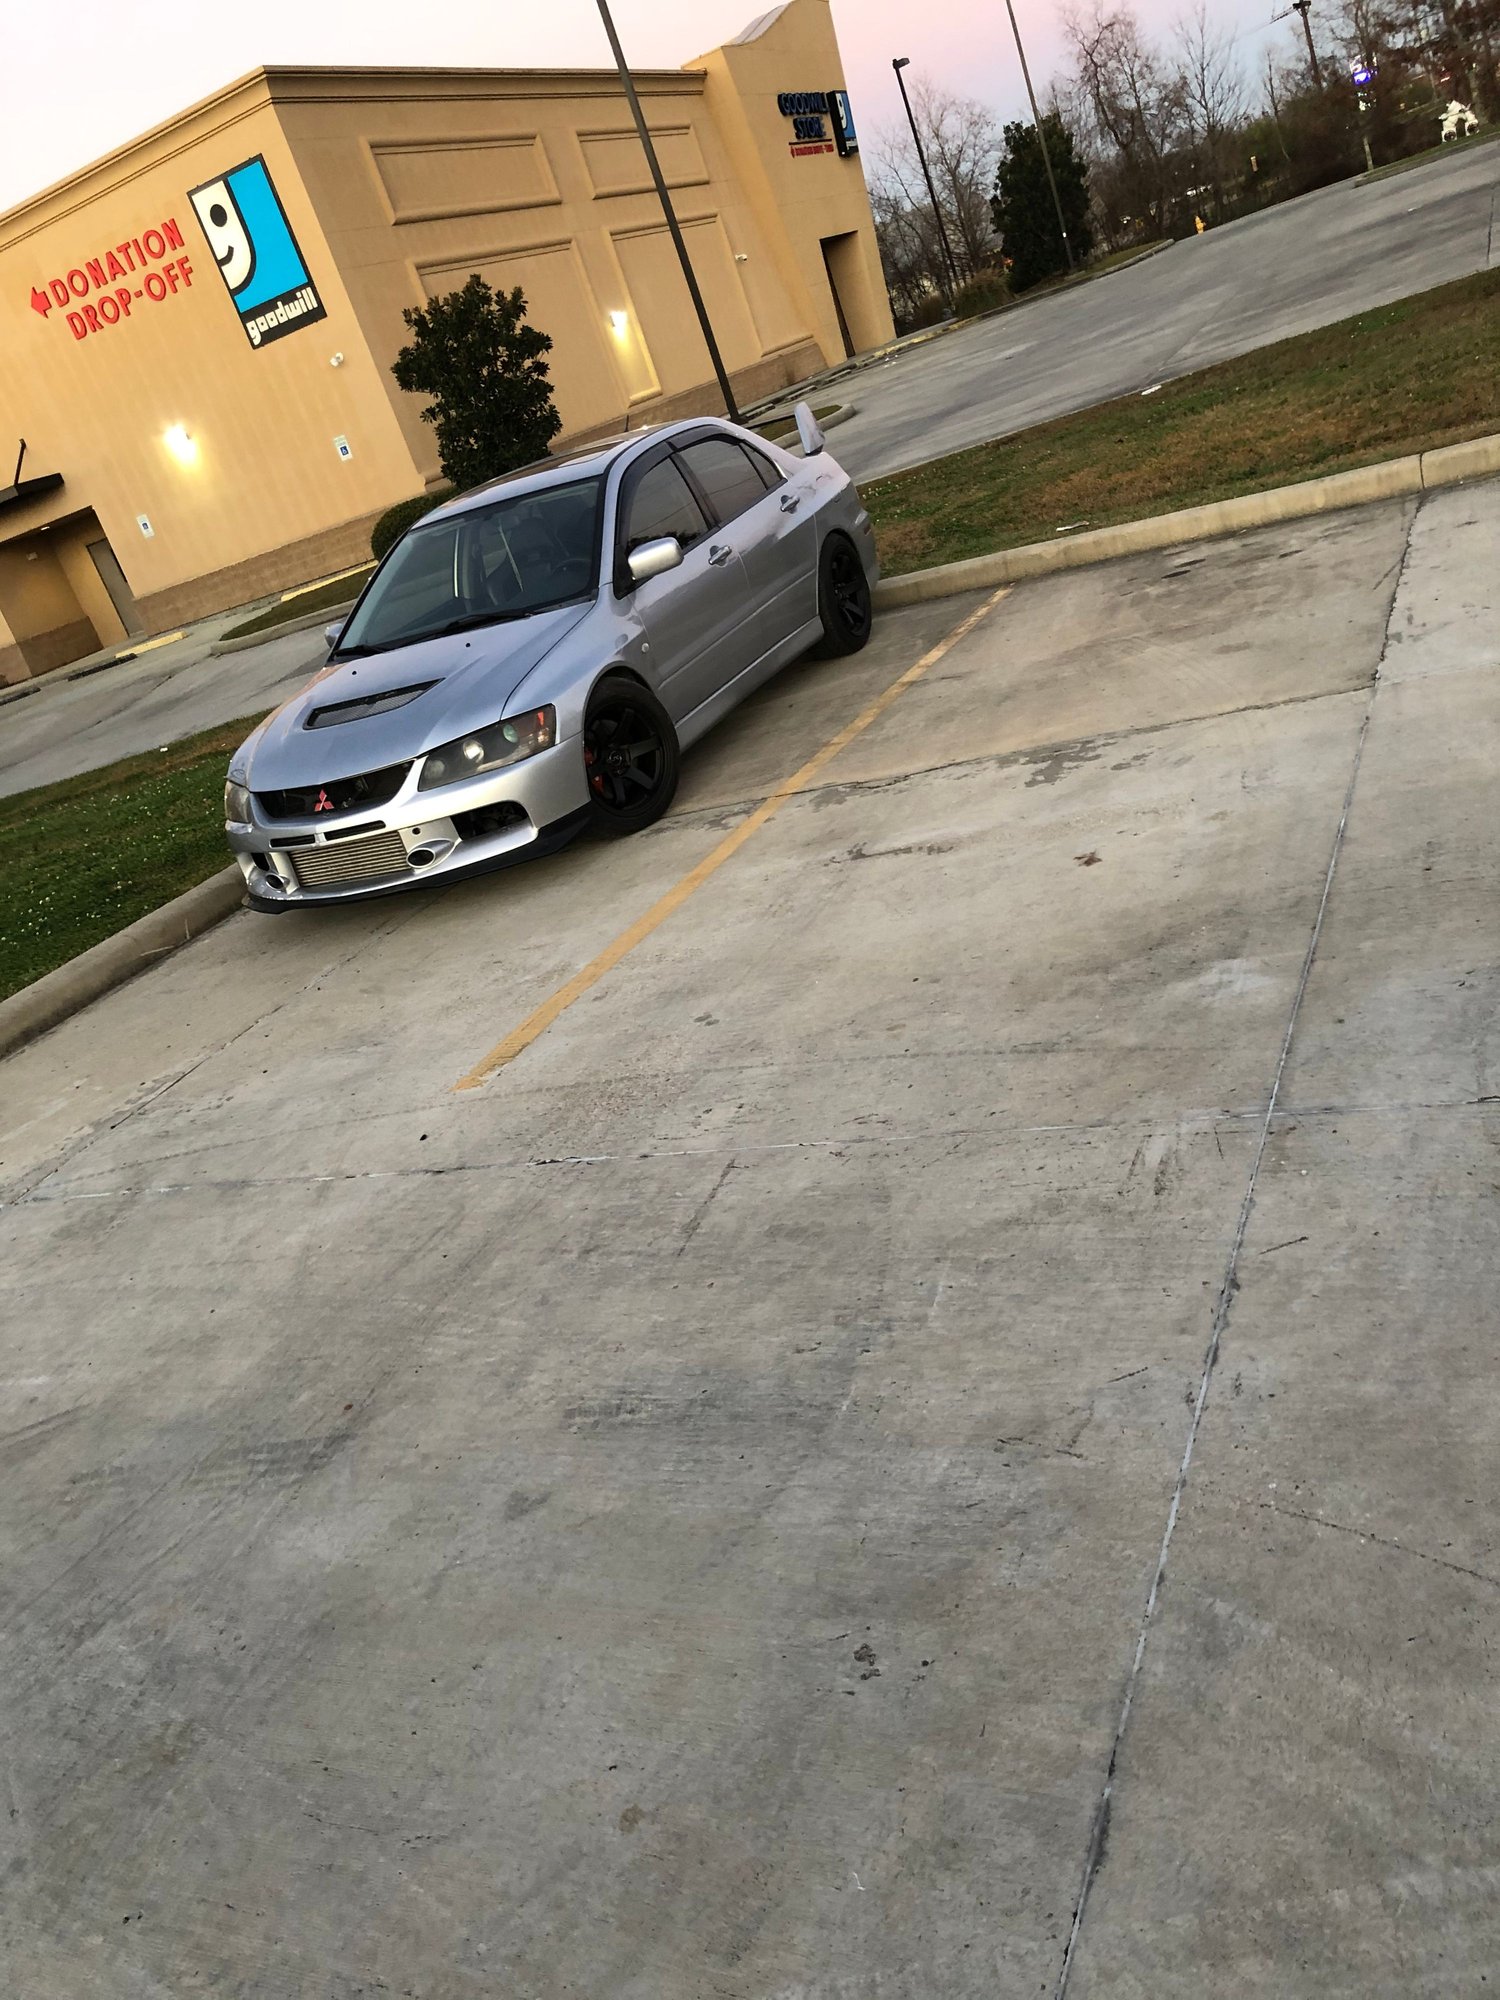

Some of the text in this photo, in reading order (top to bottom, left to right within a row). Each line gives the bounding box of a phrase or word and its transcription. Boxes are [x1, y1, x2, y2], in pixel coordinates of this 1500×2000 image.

[48, 218, 186, 308] DONATION
[65, 256, 193, 340] DROP-OFF
[246, 286, 318, 346] goodwill
